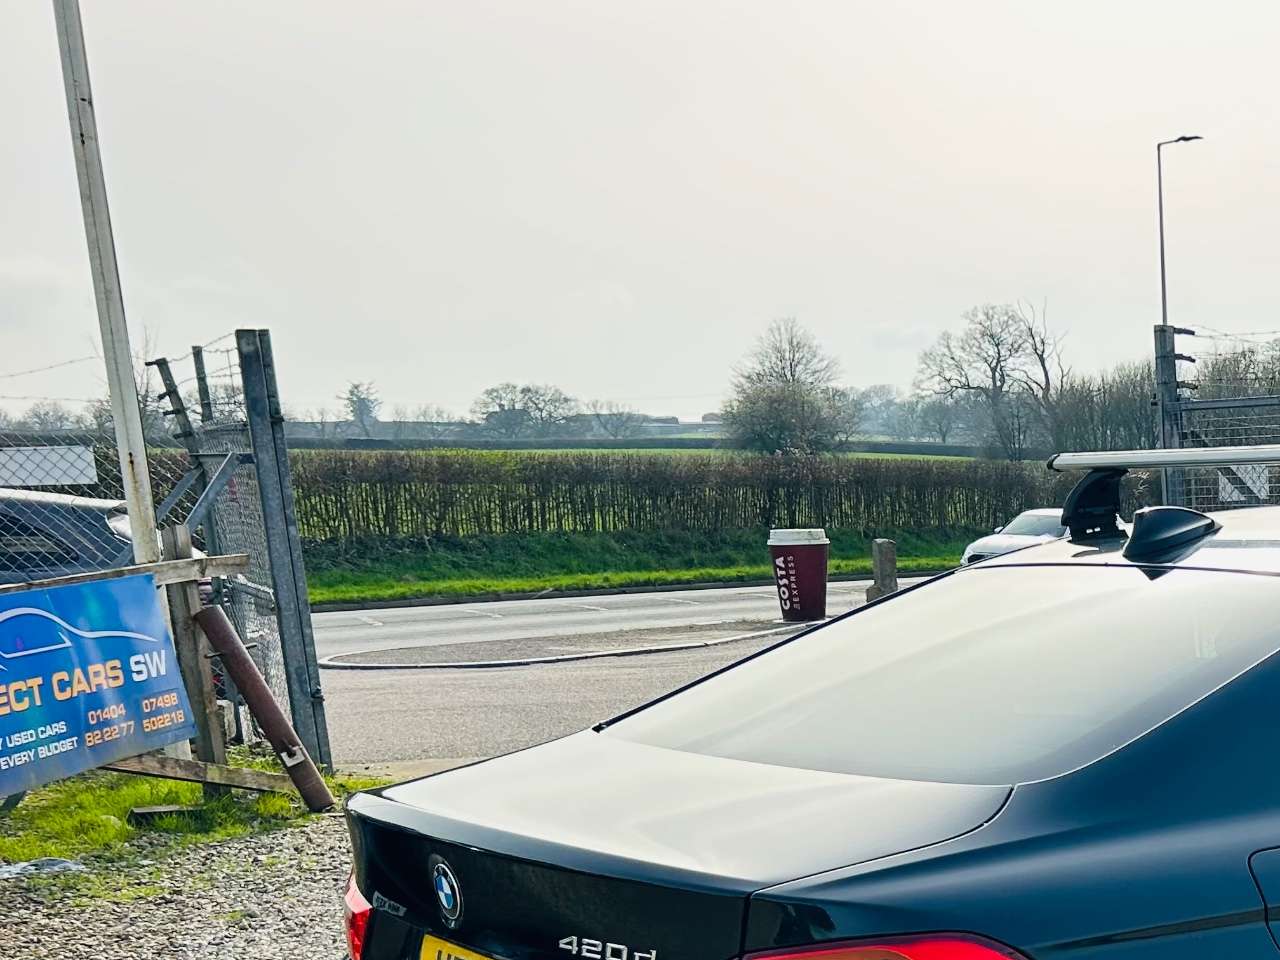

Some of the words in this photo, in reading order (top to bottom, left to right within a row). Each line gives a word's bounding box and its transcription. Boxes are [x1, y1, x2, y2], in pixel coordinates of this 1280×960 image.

[776, 557, 790, 610] COSTA
[787, 556, 800, 602] EXPRESS
[52, 659, 124, 701] CARS
[130, 650, 166, 682] SW
[88, 703, 126, 725] 01404
[142, 692, 179, 713] 07498
[143, 710, 185, 732] 502218
[6, 730, 36, 748] USED
[38, 721, 67, 739] CARS
[0, 749, 35, 770] EVERY
[38, 736, 78, 759] BUDGET
